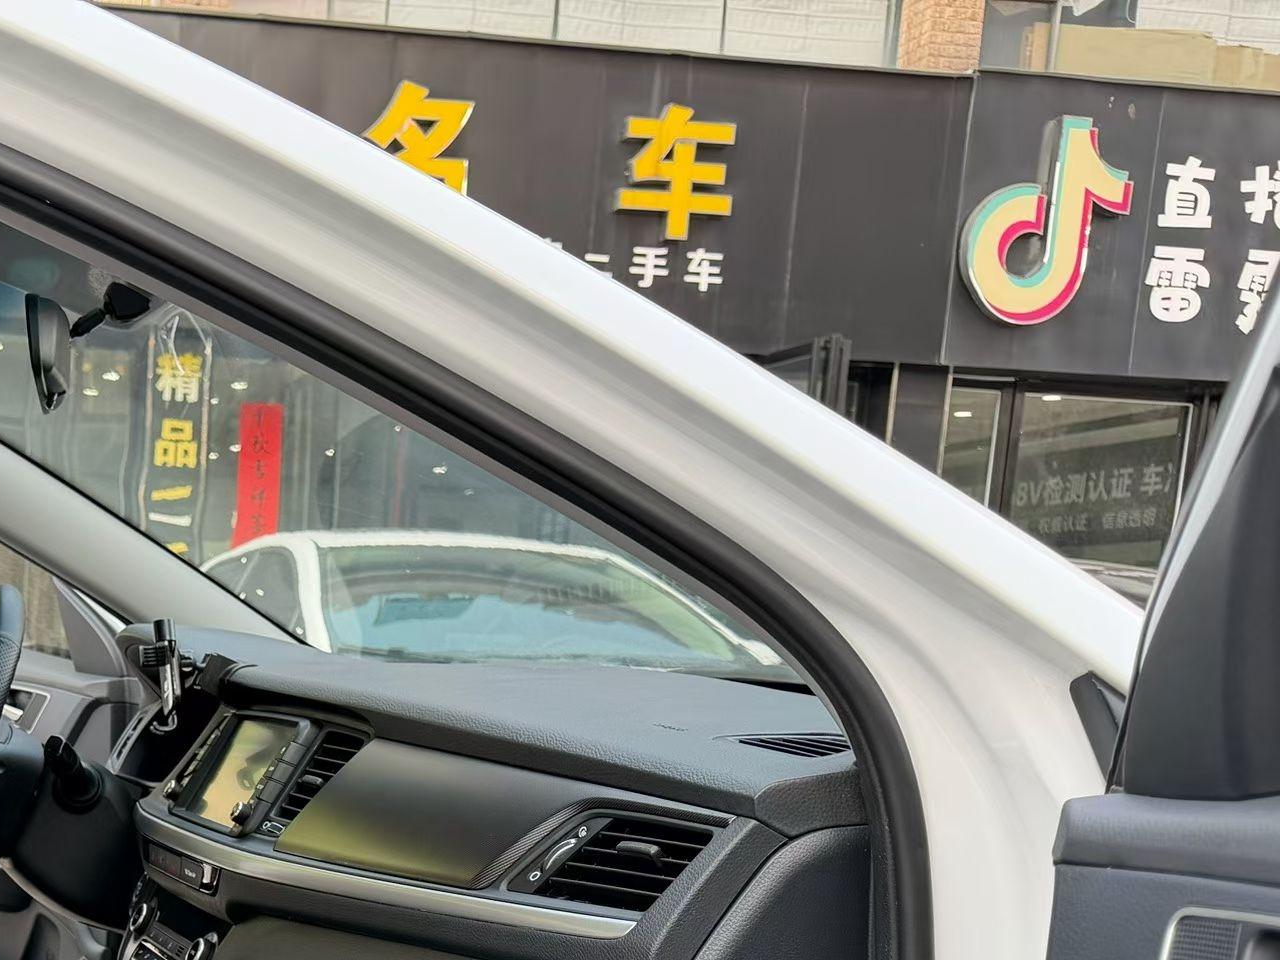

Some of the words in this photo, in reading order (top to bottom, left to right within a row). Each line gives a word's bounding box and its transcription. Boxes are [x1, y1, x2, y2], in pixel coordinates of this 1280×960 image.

[543, 236, 725, 293] 二手车
[148, 352, 204, 555] 精品二
